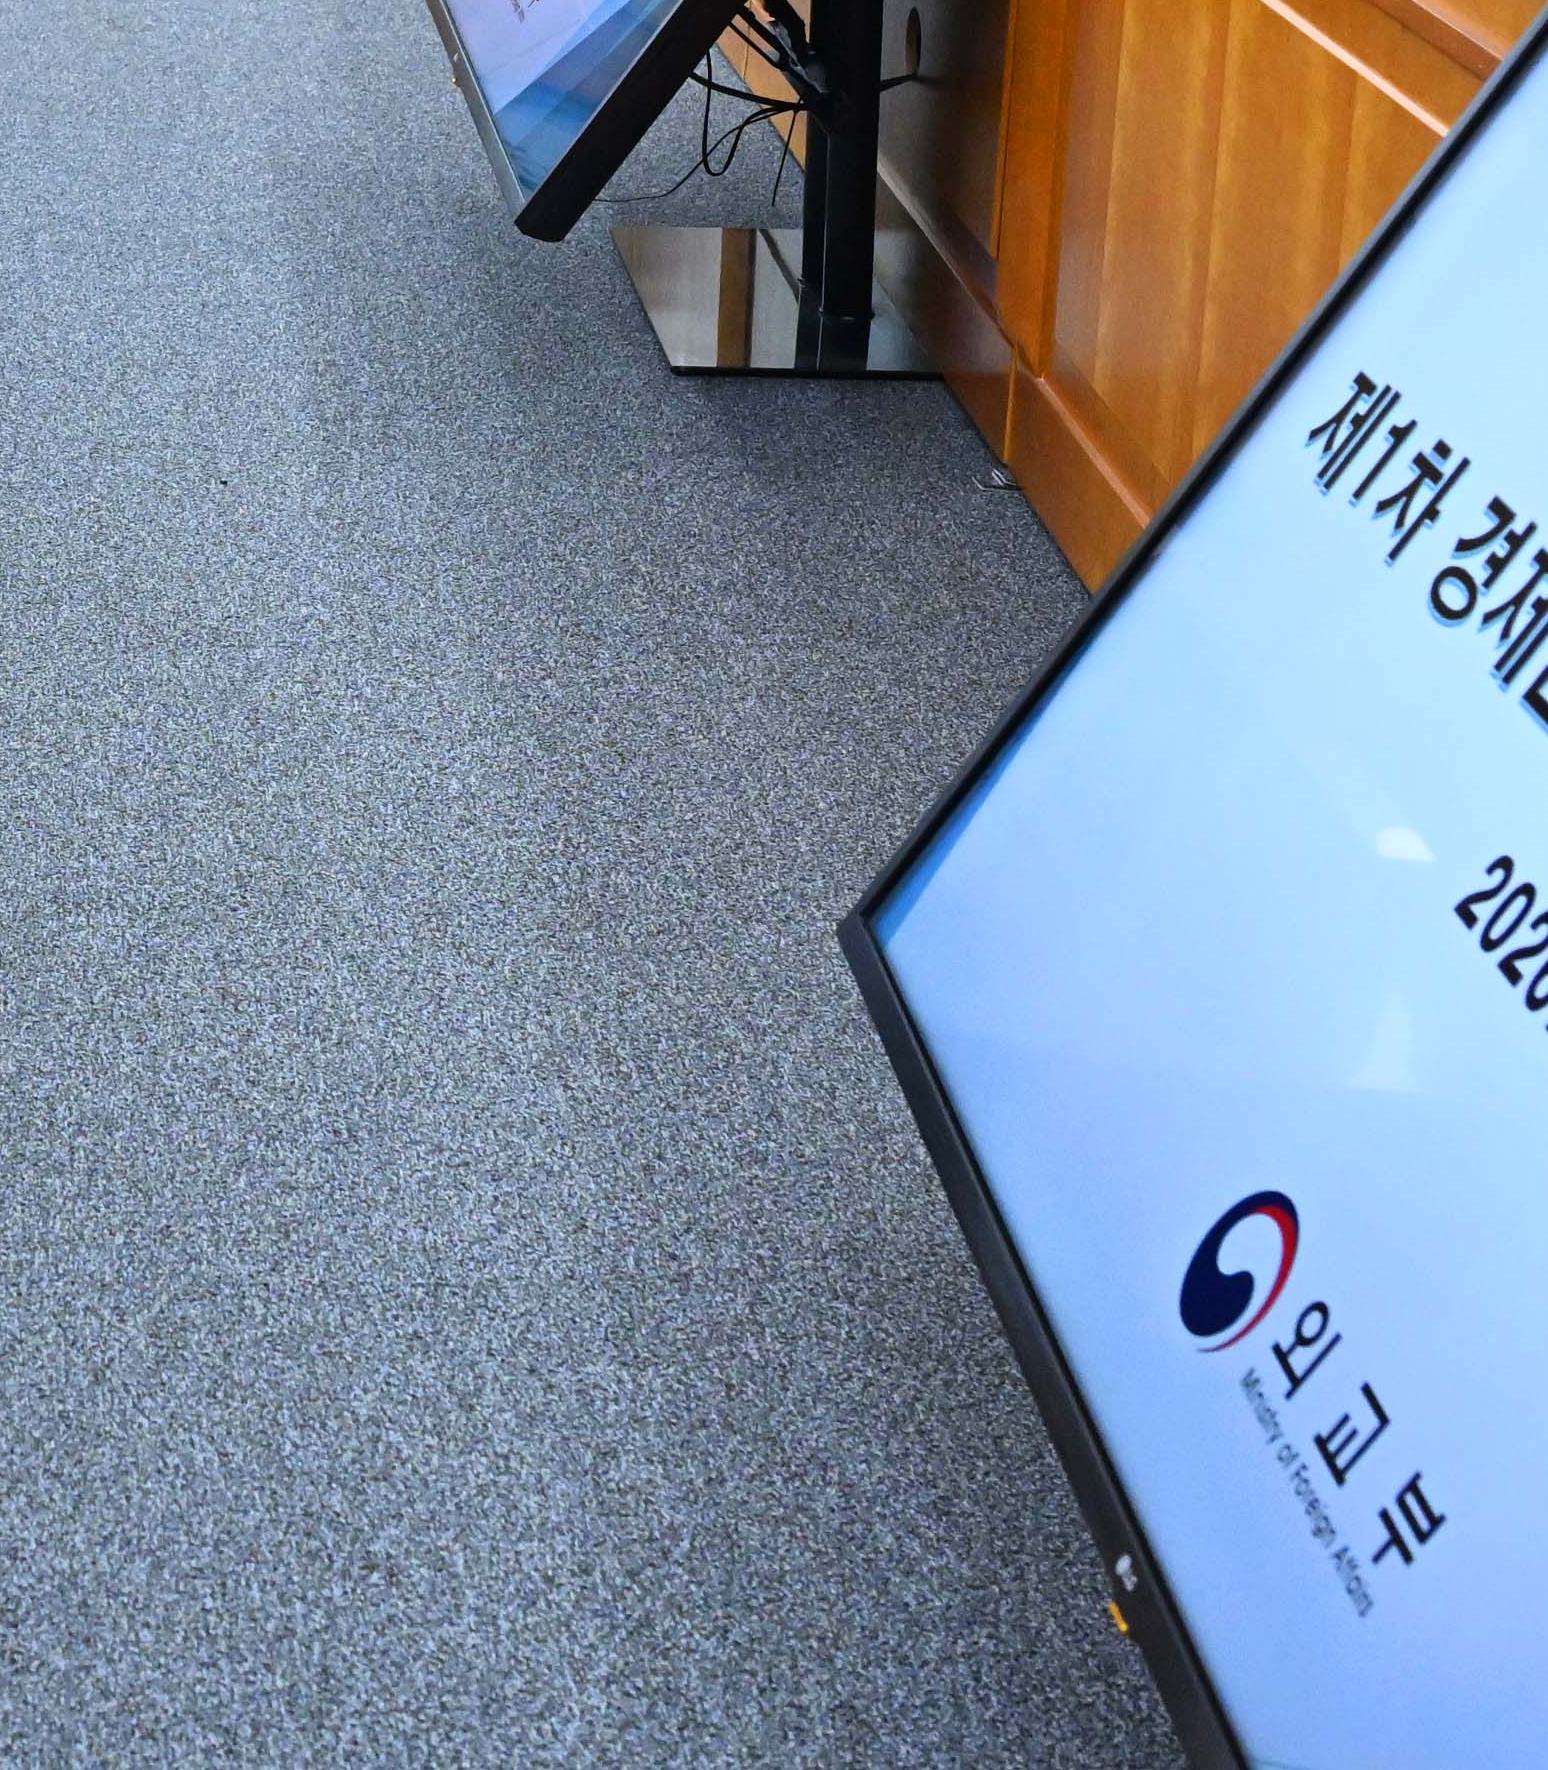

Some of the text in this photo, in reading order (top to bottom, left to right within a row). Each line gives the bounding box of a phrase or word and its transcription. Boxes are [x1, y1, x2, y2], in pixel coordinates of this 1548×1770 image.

[1308, 372, 1462, 561] 제1차
[1240, 1367, 1283, 1446] Ministry
[1277, 1441, 1301, 1468] of
[1289, 1463, 1337, 1548] Foreign
[1271, 1301, 1446, 1565] 외교부
